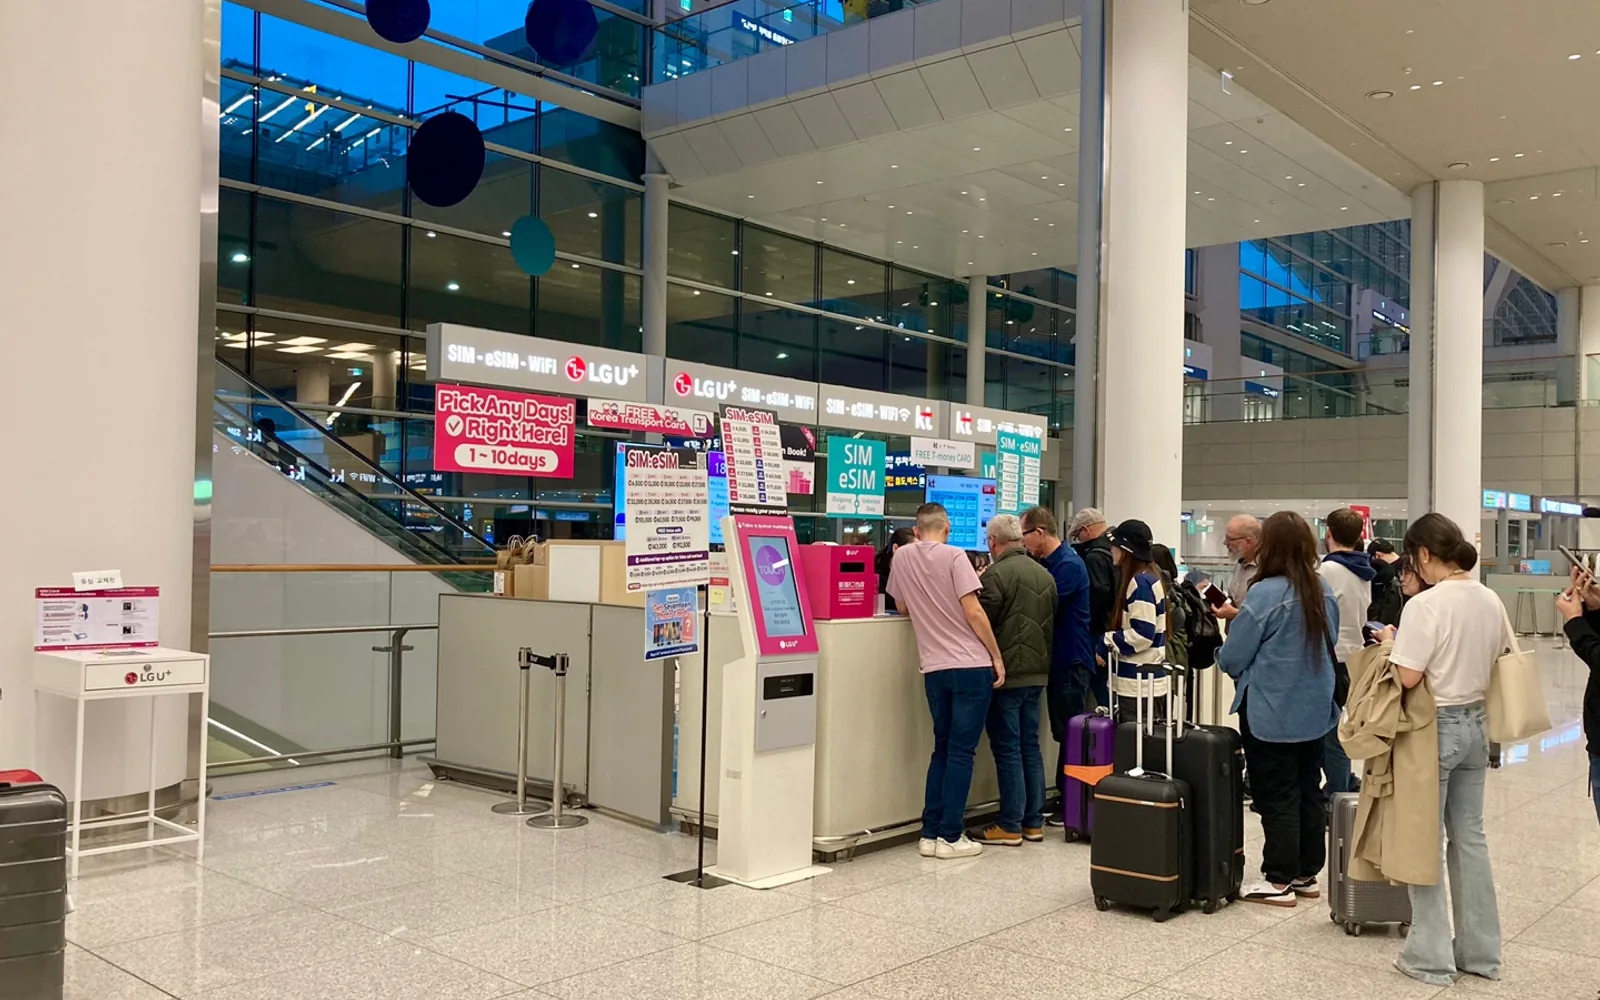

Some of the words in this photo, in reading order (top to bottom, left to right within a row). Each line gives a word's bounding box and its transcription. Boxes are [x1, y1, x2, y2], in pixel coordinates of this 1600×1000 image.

[448, 344, 475, 364] SIM
[485, 350, 519, 370] eSIM
[528, 355, 557, 375] WiFi
[438, 390, 484, 414] Pick
[485, 395, 523, 421] Any
[525, 399, 574, 426] Days!
[741, 387, 760, 403] SIM
[766, 392, 790, 407] eSIM
[590, 411, 618, 423] Korea
[620, 413, 663, 428] Transport
[664, 418, 686, 430] Card
[625, 405, 655, 420] FREE
[826, 398, 845, 415] SIM
[851, 402, 874, 418] eSIM
[915, 404, 933, 430] kt
[956, 410, 973, 435] kt
[466, 417, 520, 444] Right
[521, 422, 567, 446] Here!
[844, 443, 872, 466] SIM
[915, 450, 930, 460] FREE
[957, 454, 972, 463] CARD
[1000, 436, 1016, 450] SIM
[1020, 441, 1039, 455] eSIM
[491, 450, 547, 470] 10days
[839, 468, 876, 490] eSIM
